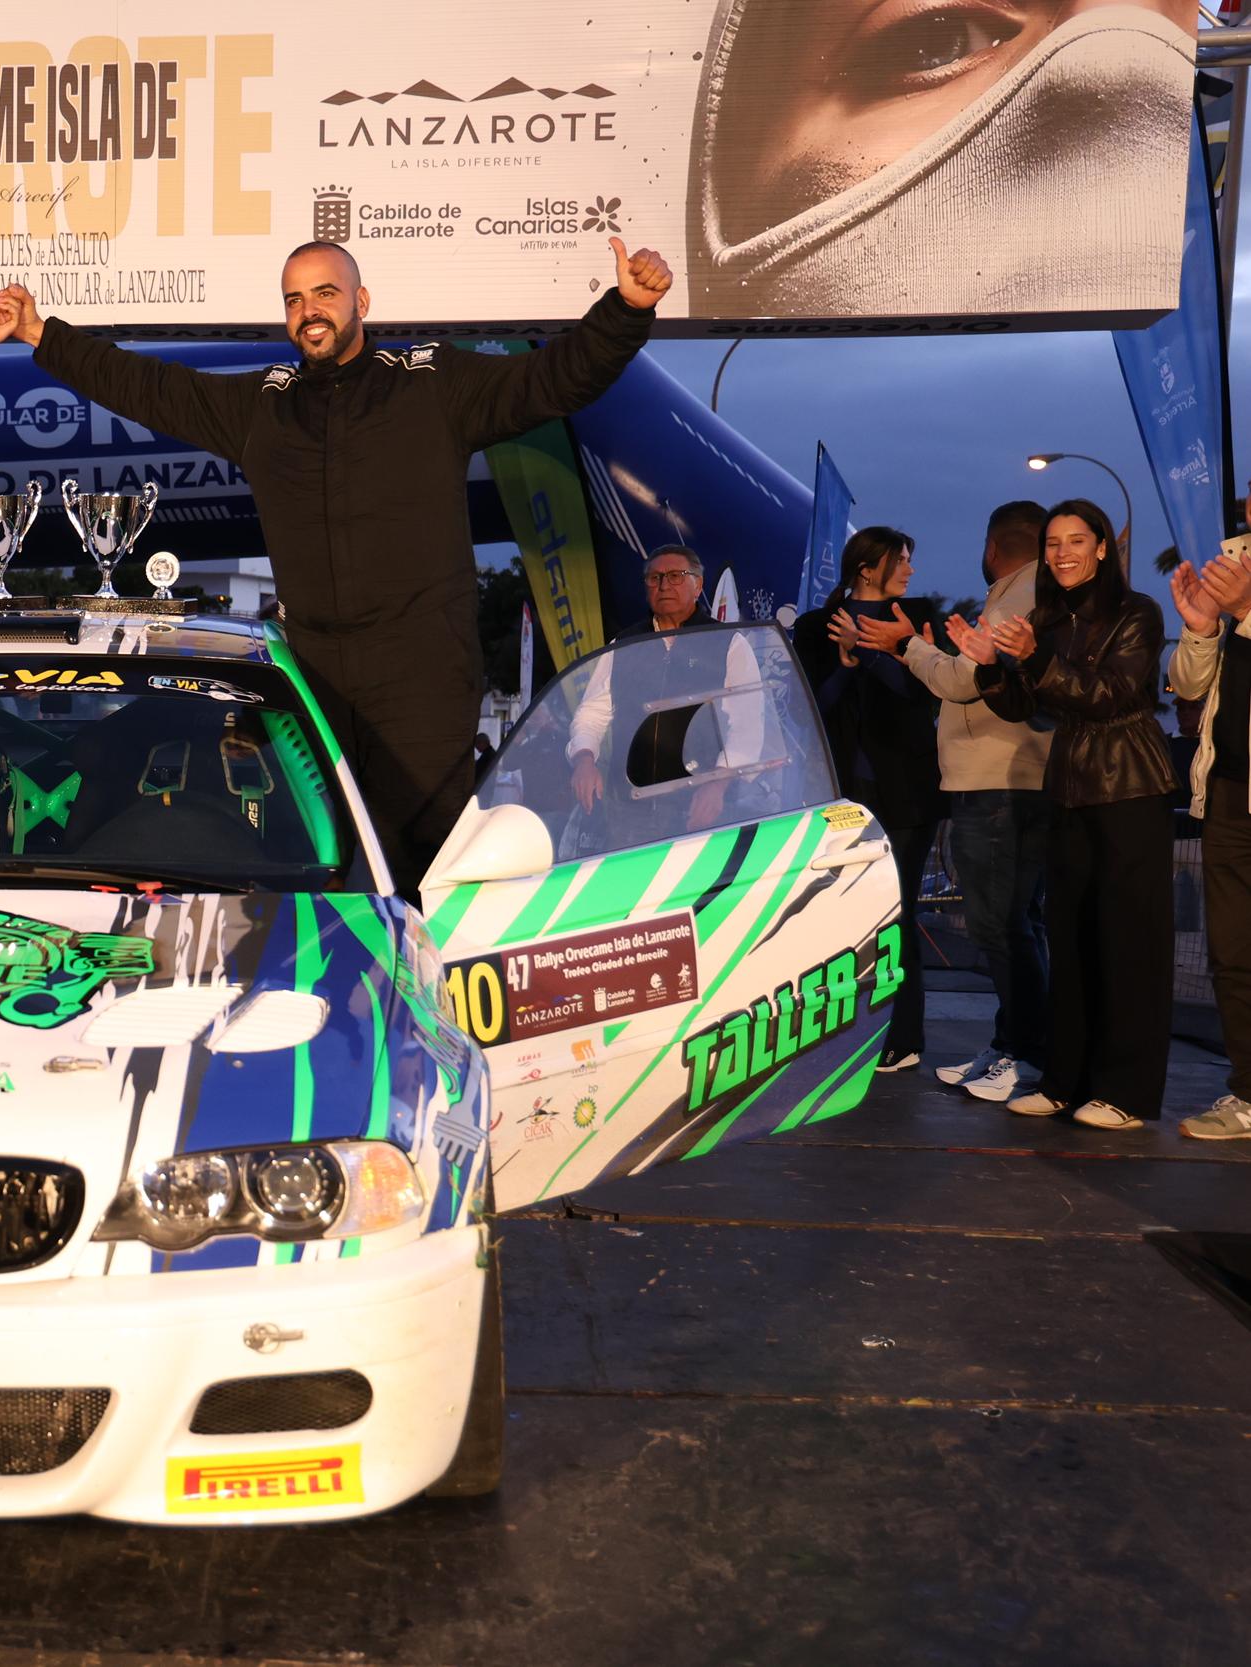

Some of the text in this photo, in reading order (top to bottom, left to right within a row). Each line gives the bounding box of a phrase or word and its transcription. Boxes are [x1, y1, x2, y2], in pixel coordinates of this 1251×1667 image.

[47, 62, 121, 163] ISLA
[134, 62, 178, 160] DE
[319, 112, 617, 147] LANZAROTE
[391, 156, 543, 169] LA ISLA DIFERENTE
[359, 203, 462, 220] Cabildo de
[527, 198, 579, 216] Islas
[359, 222, 455, 239] Lanzarote
[475, 216, 579, 235] Canarias
[35, 241, 45, 267] de
[48, 231, 110, 267] ASFALTO
[551, 240, 560, 250] DE
[562, 240, 578, 250] VIDA
[40, 271, 102, 306] INSULAR
[104, 280, 115, 305] de
[117, 269, 206, 304] LANZAROTE
[411, 350, 433, 362] OMP
[57, 406, 86, 423] DE
[29, 467, 80, 496] DE
[94, 460, 249, 493] LANZAR
[153, 677, 200, 691] EN-VIA
[534, 923, 691, 971] Rallye Orvecame Isla de Lanzarote
[563, 948, 669, 980] Trofeo Ciudad de Arrecife
[507, 955, 529, 992] 47
[446, 962, 503, 1042] 10
[607, 990, 627, 1002] Cabildo
[607, 996, 634, 1008] Lanzarote
[516, 1002, 584, 1026] LANZAROTE
[588, 1084, 599, 1094] bp
[524, 1122, 552, 1139] CICAR
[183, 1456, 344, 1501] PIRELLI
